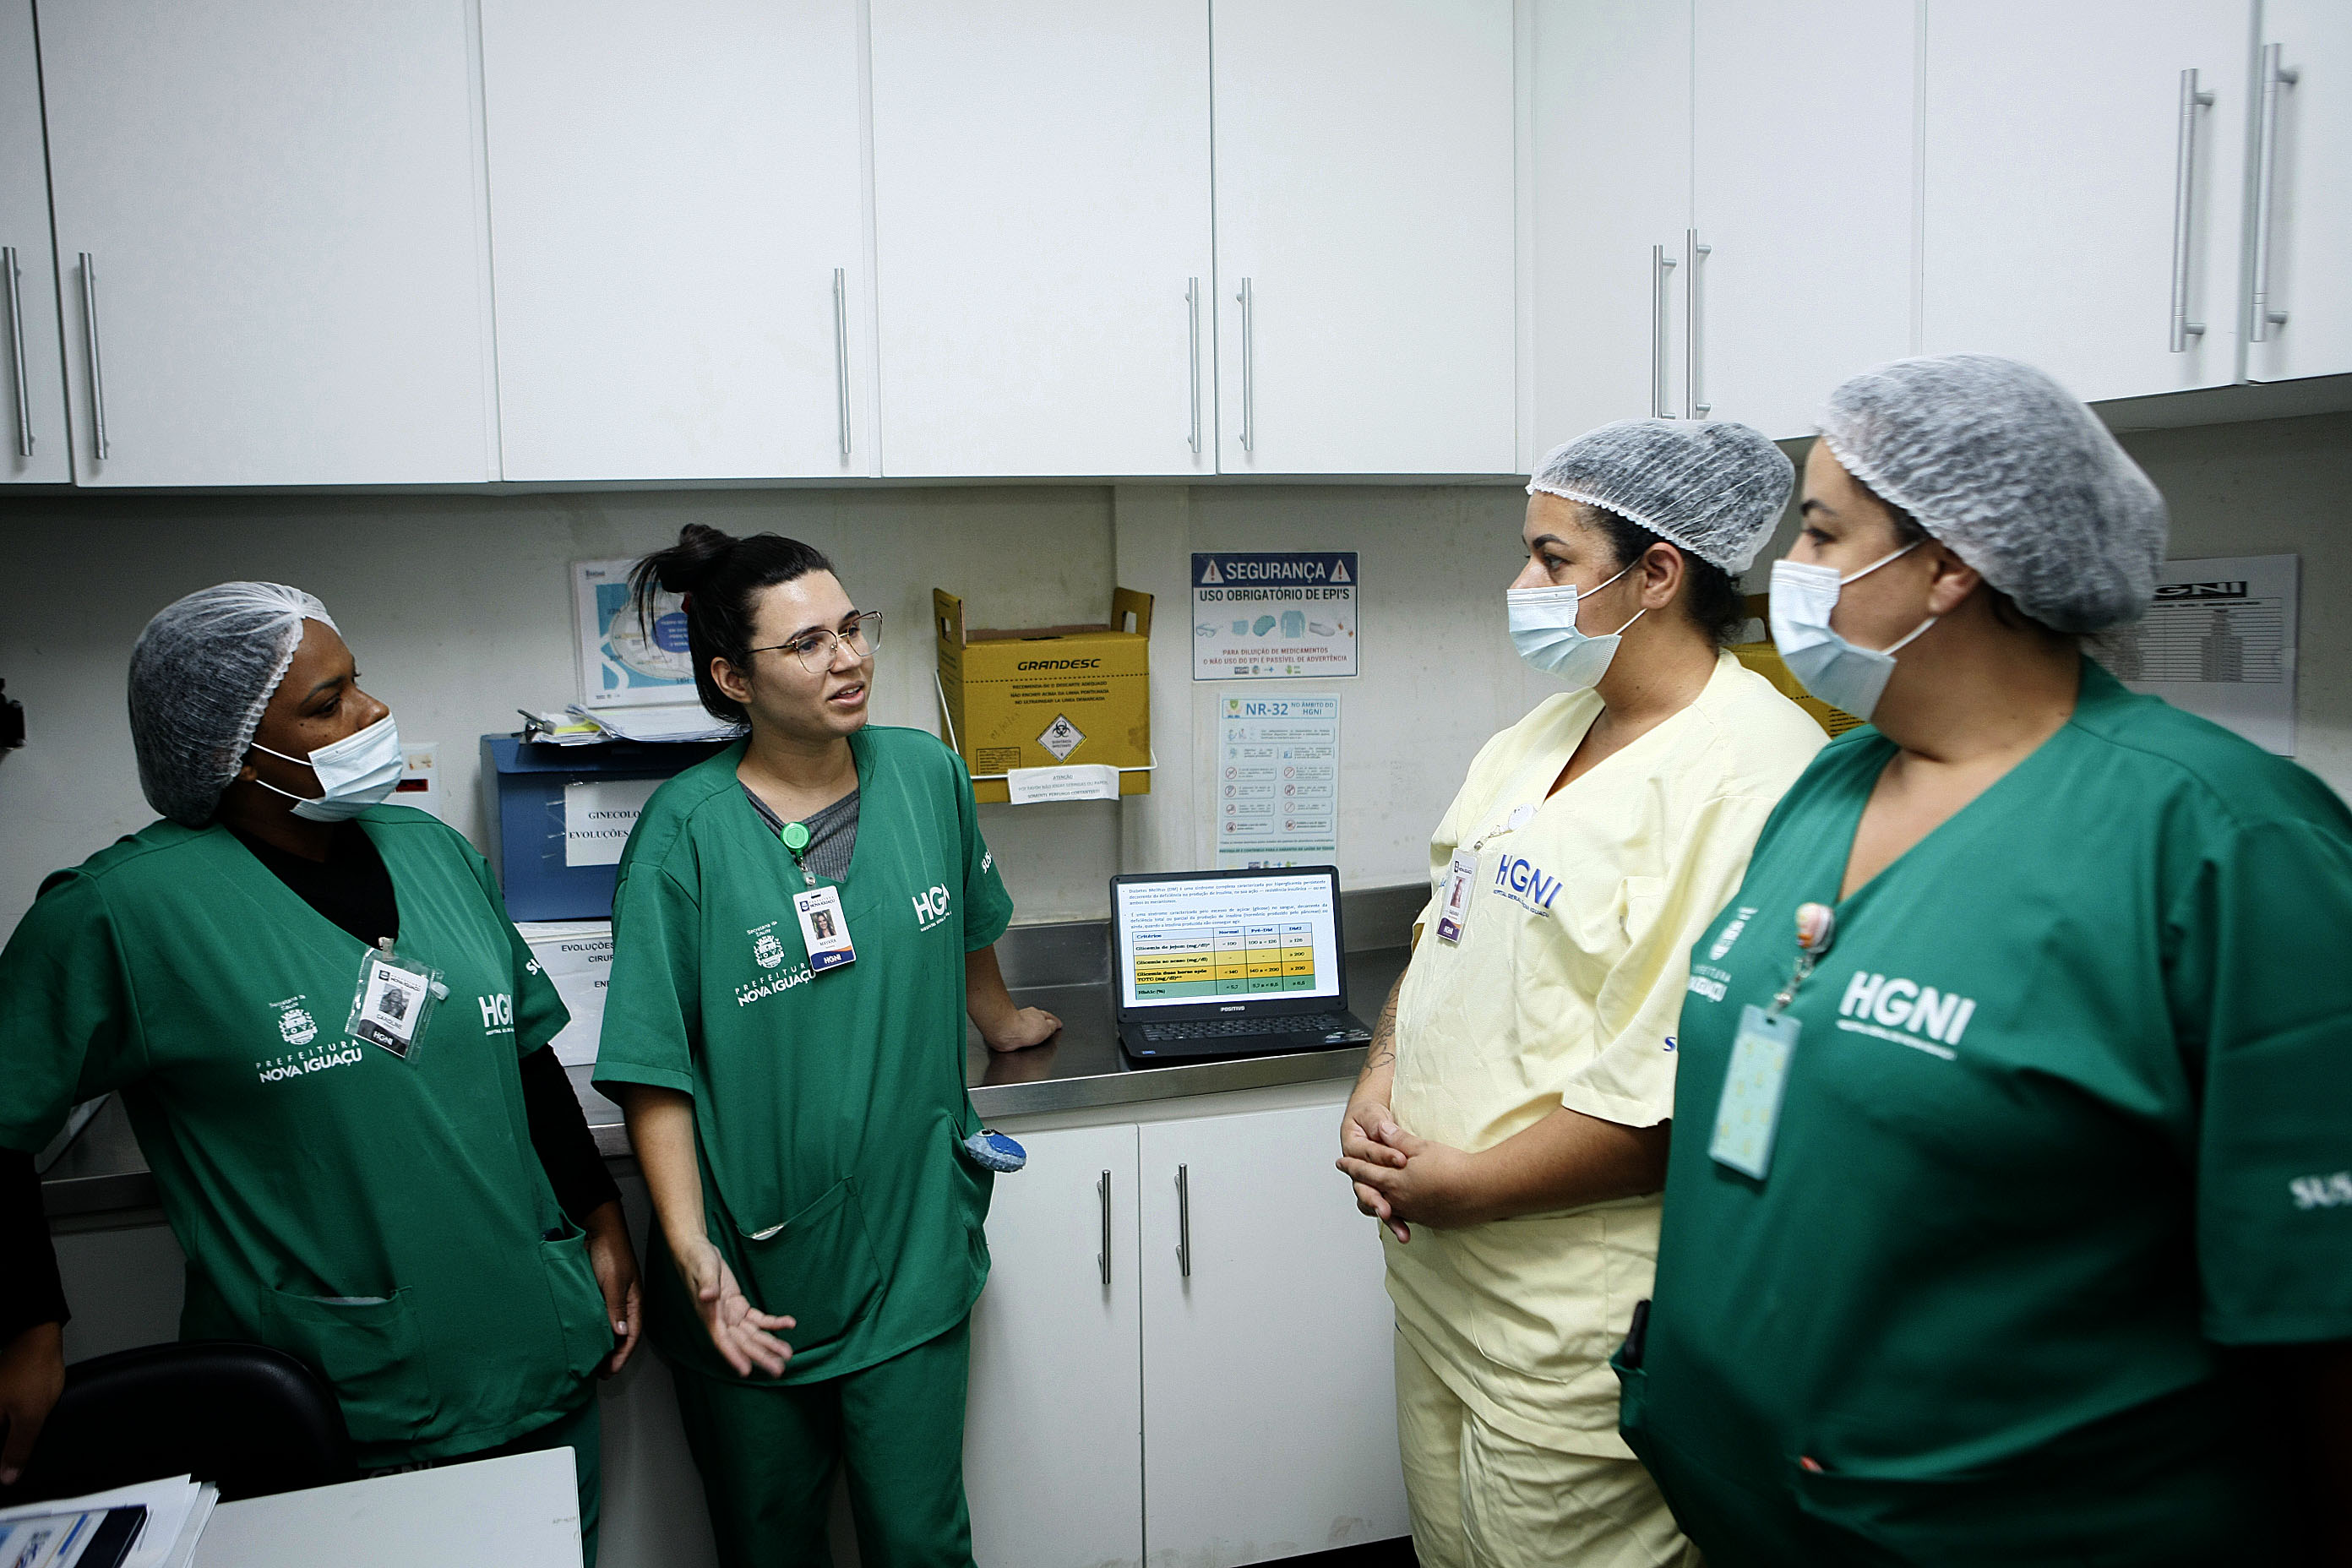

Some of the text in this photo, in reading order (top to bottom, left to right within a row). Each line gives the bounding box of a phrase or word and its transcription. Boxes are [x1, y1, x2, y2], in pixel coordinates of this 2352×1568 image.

[1227, 563, 1326, 583] SEGURANÇA
[1200, 587, 1349, 602] USO OBRIGATÓRIO DE EPI'S
[1017, 659, 1101, 671] GRANDESC
[1247, 703, 1288, 716] NR-32
[569, 829, 630, 839] EVOLUÇÕES
[1495, 853, 1563, 909] HGNI
[562, 941, 615, 951] EVOLUÇÕES
[824, 954, 841, 964] HGNI
[738, 970, 816, 1007] NOVA IGUAÇU
[1838, 971, 1977, 1046] HGNI
[373, 1031, 394, 1045] HGNI
[256, 1039, 359, 1069] PREFEITURA
[259, 1048, 362, 1083] NOVA IGUAÇU
